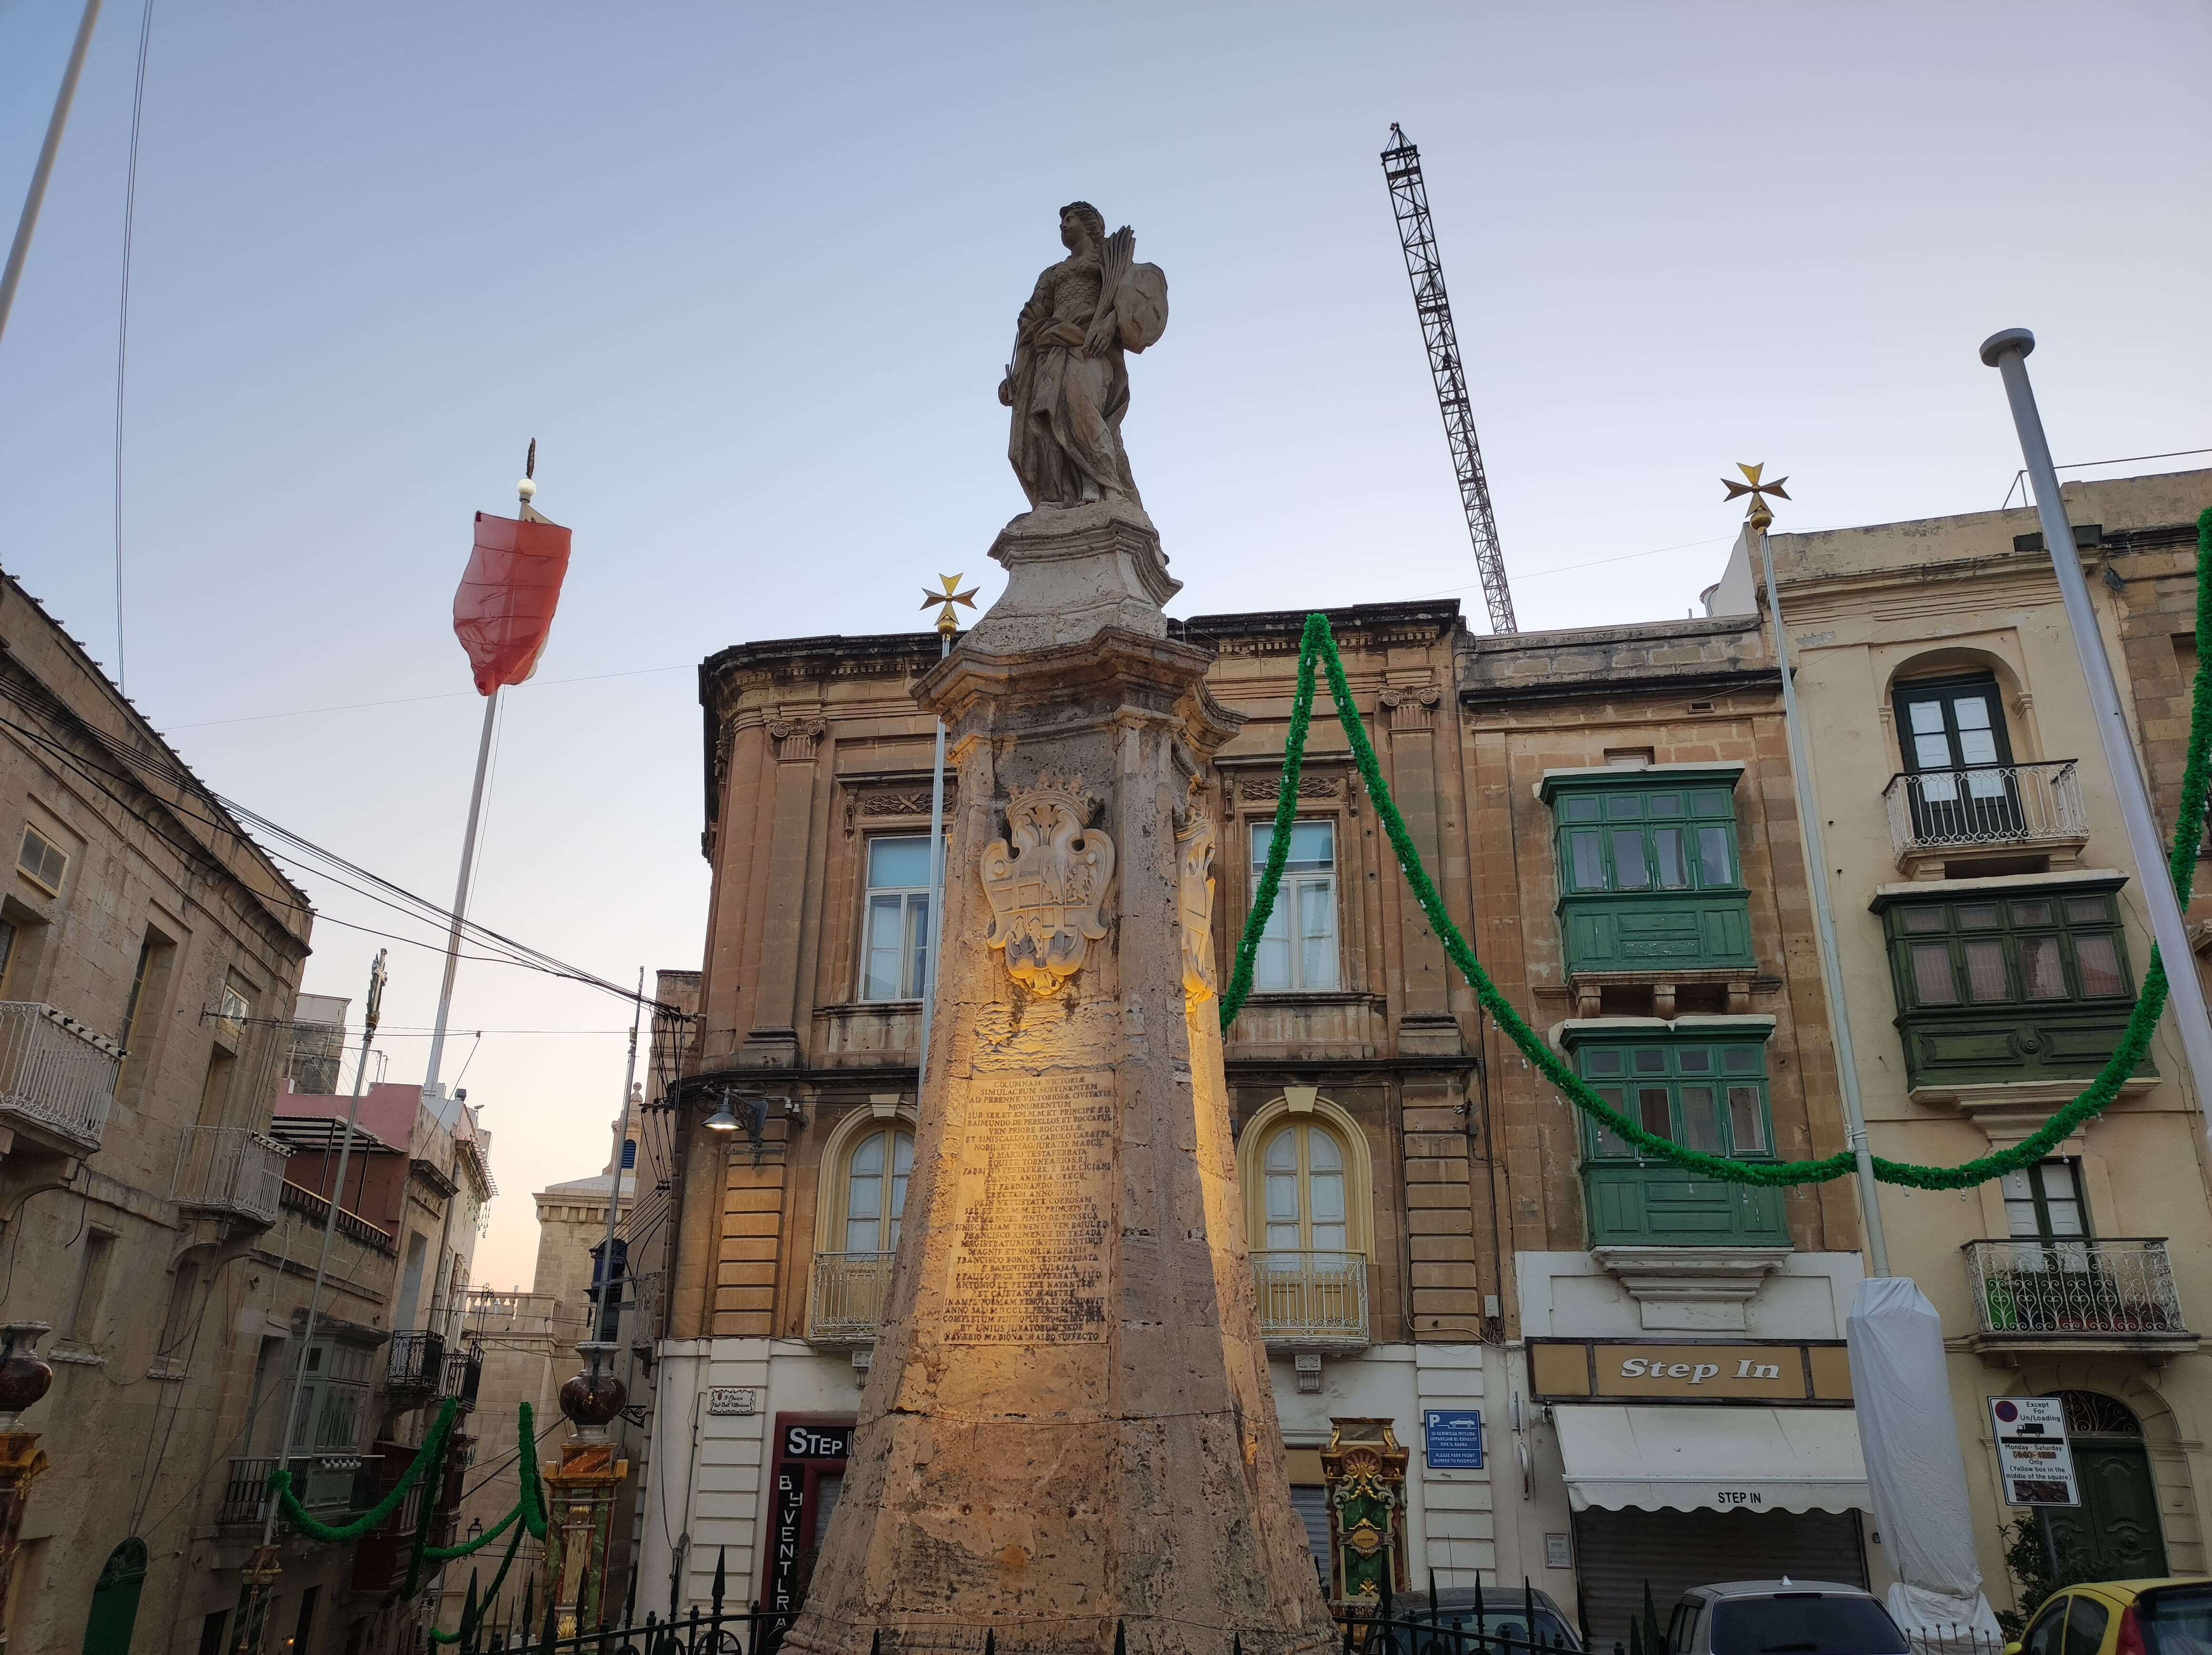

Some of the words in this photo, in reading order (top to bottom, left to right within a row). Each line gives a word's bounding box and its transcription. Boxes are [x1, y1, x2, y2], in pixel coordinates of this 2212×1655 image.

[981, 1087, 1036, 1095] SIMULACRUM
[1039, 1083, 1098, 1093] SUSTINENTEM
[1073, 1090, 1111, 1099] CIVITATIS
[1008, 1101, 1072, 1111] MONUMENTUM
[1060, 1107, 1095, 1115] PRINCIPE
[1025, 1148, 1087, 1157] TESTAFERRATA
[1029, 1190, 1053, 1198] ANNO
[1620, 1358, 1719, 1384] Step
[1731, 1359, 1780, 1379] In
[2020, 1414, 2060, 1422] Un/Loading
[1717, 1492, 1746, 1503] STEP
[1749, 1492, 1762, 1504] IN
